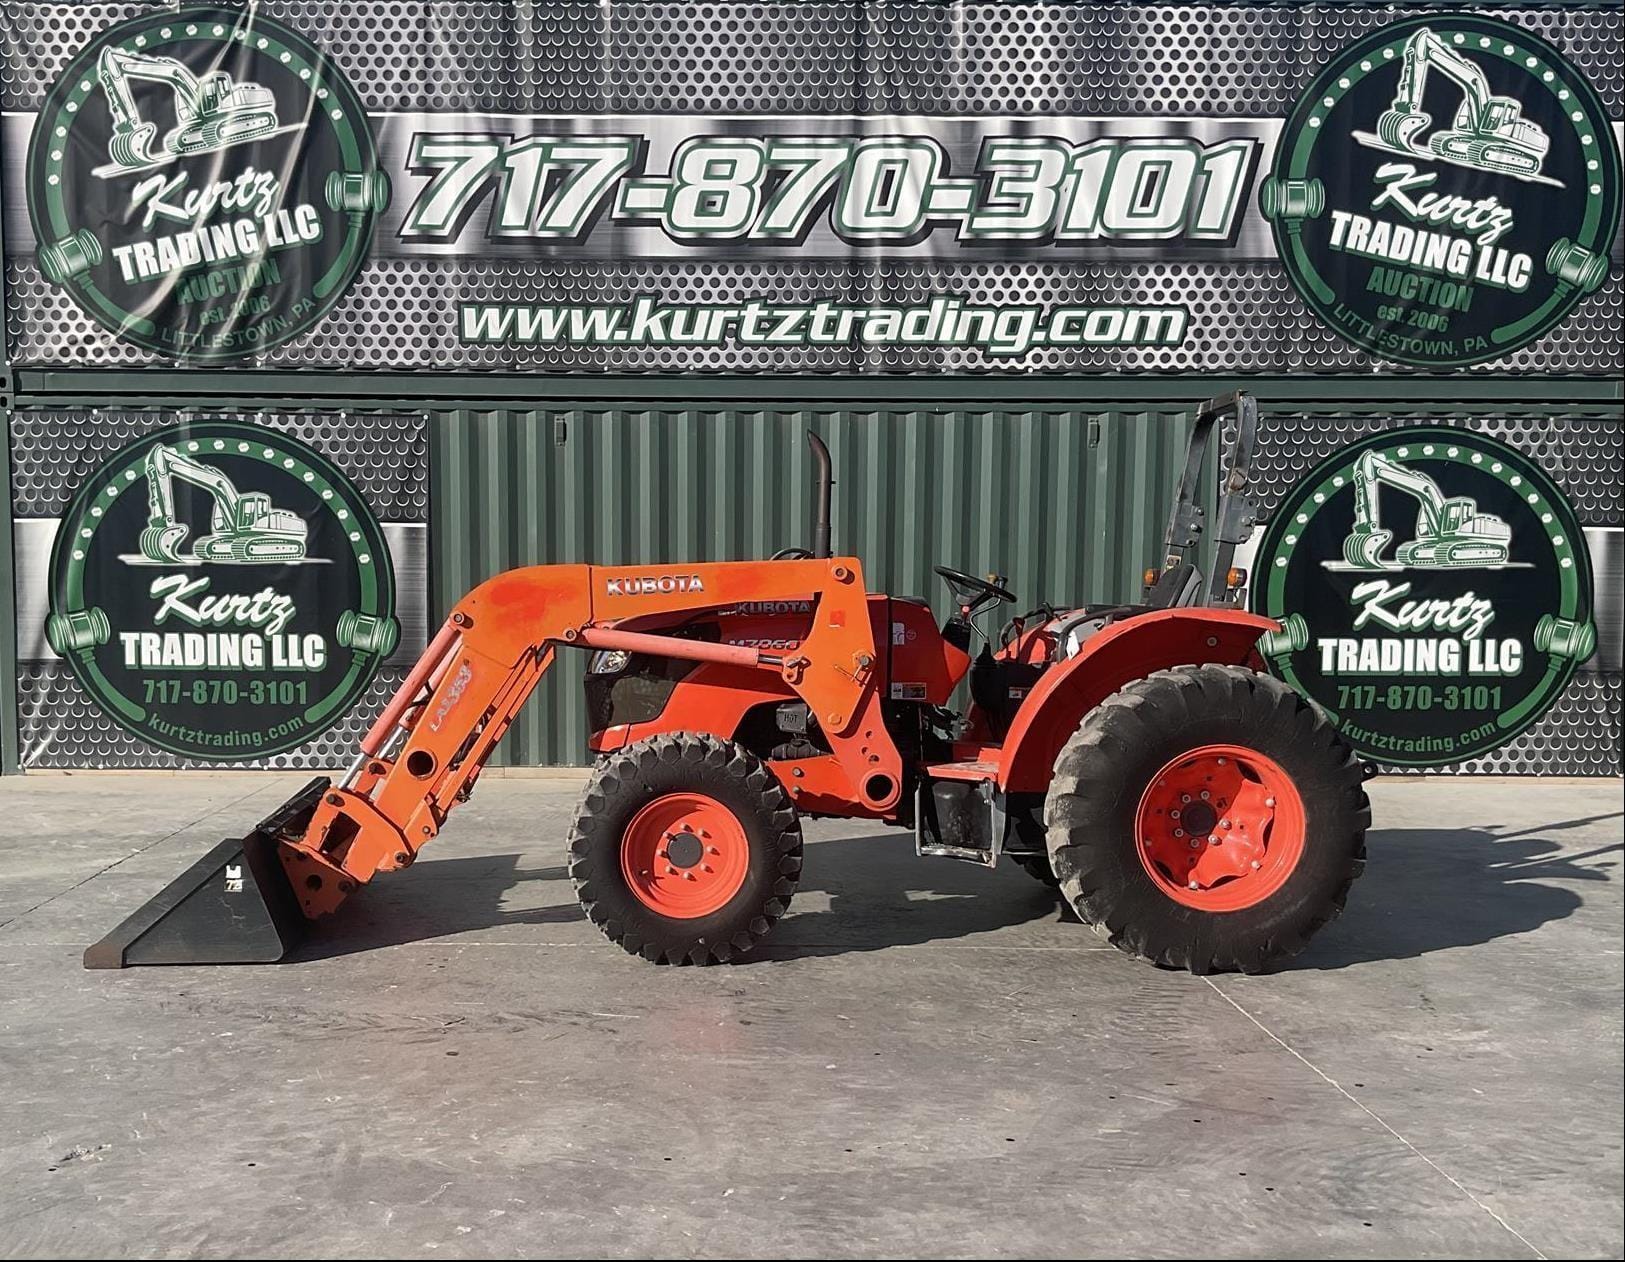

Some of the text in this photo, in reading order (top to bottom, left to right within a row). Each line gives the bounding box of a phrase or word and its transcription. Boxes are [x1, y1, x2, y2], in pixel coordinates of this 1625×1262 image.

[133, 167, 280, 230] Kurtz
[401, 133, 1256, 246] 717-870-3101
[1371, 162, 1514, 246] Kurtz
[113, 204, 324, 284] TRADING LLC
[1329, 210, 1534, 292] TRADING LLC
[176, 259, 281, 305] AUCTION
[1366, 266, 1474, 312] AUCTION
[291, 298, 316, 319] PA
[461, 296, 1188, 356] www.kurtztrading.com
[1333, 303, 1488, 356] LITTLESTOWN, PA
[1377, 304, 1449, 333] est. 2006
[150, 573, 296, 635] Kurtz
[607, 575, 704, 596] KUBOTA
[737, 601, 810, 614] KUBOTA
[1351, 579, 1494, 640] Kurtz
[119, 632, 327, 670] TRADING LLC
[1318, 638, 1522, 676] TRADING LLC
[143, 679, 308, 705] 717-870-3101
[1337, 686, 1502, 711] 717-870-3101
[149, 714, 304, 748] kurtztrading.com
[1340, 719, 1497, 752] kurtztrading.com
